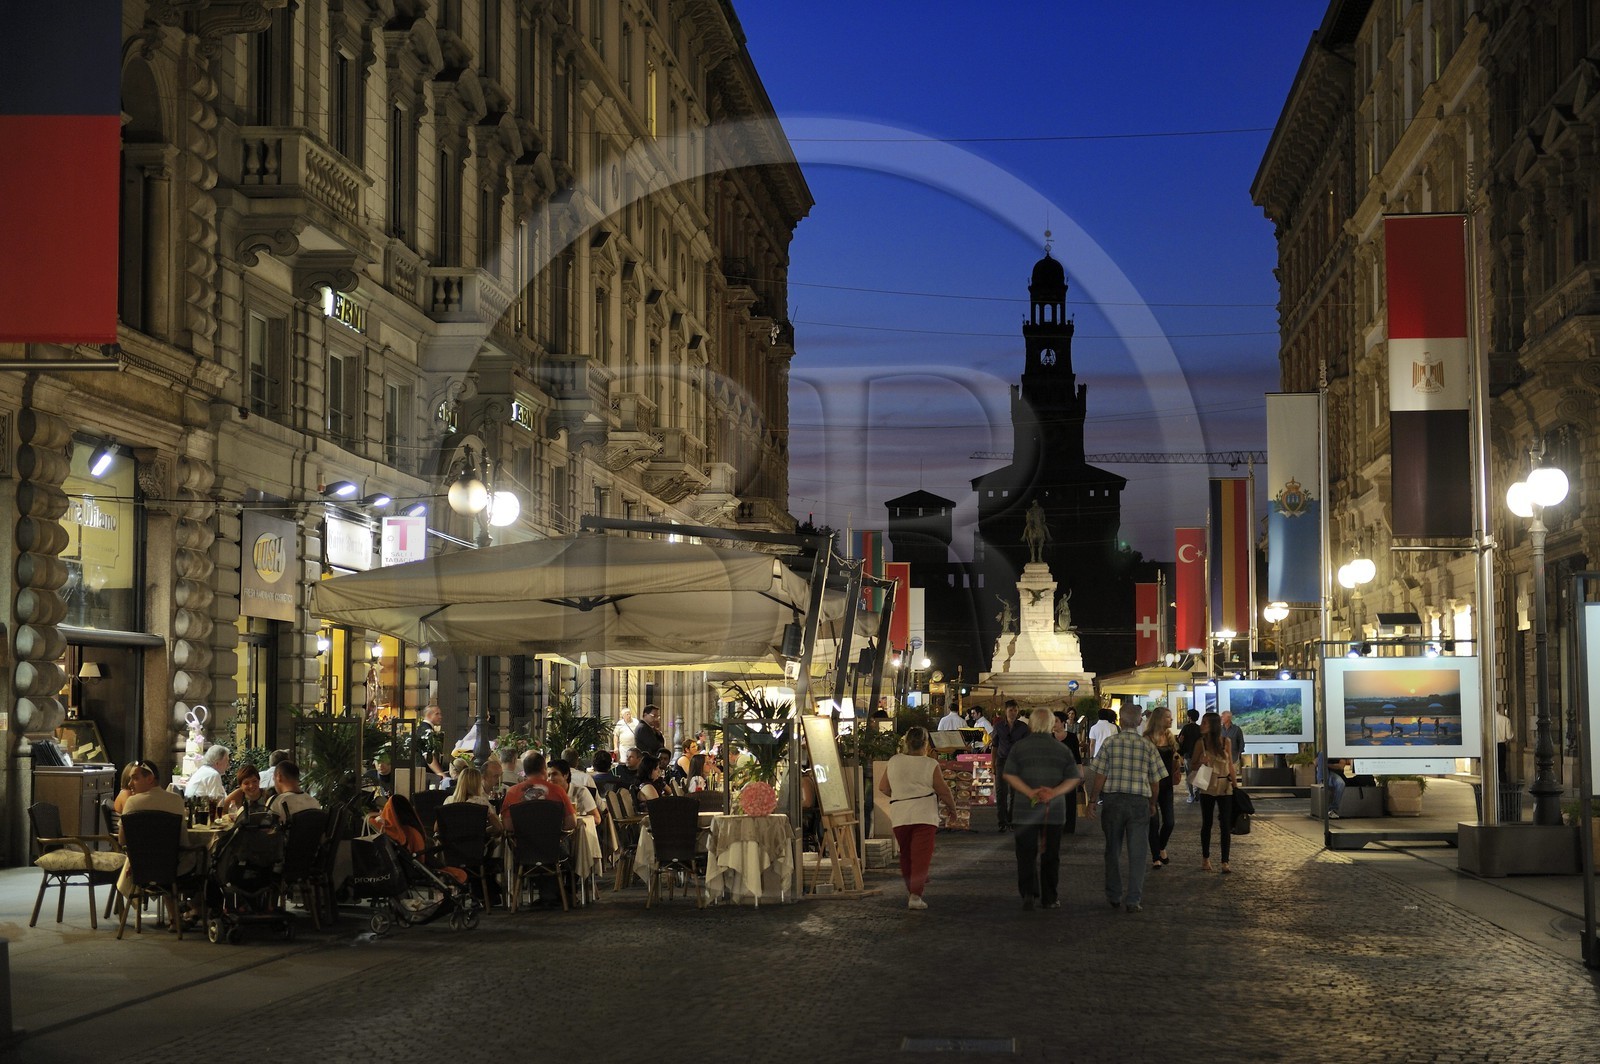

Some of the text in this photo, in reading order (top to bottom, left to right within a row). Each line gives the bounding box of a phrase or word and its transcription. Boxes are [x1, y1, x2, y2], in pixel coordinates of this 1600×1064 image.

[386, 519, 420, 551] T
[256, 536, 285, 573] LUSH
[354, 873, 391, 884] promod
